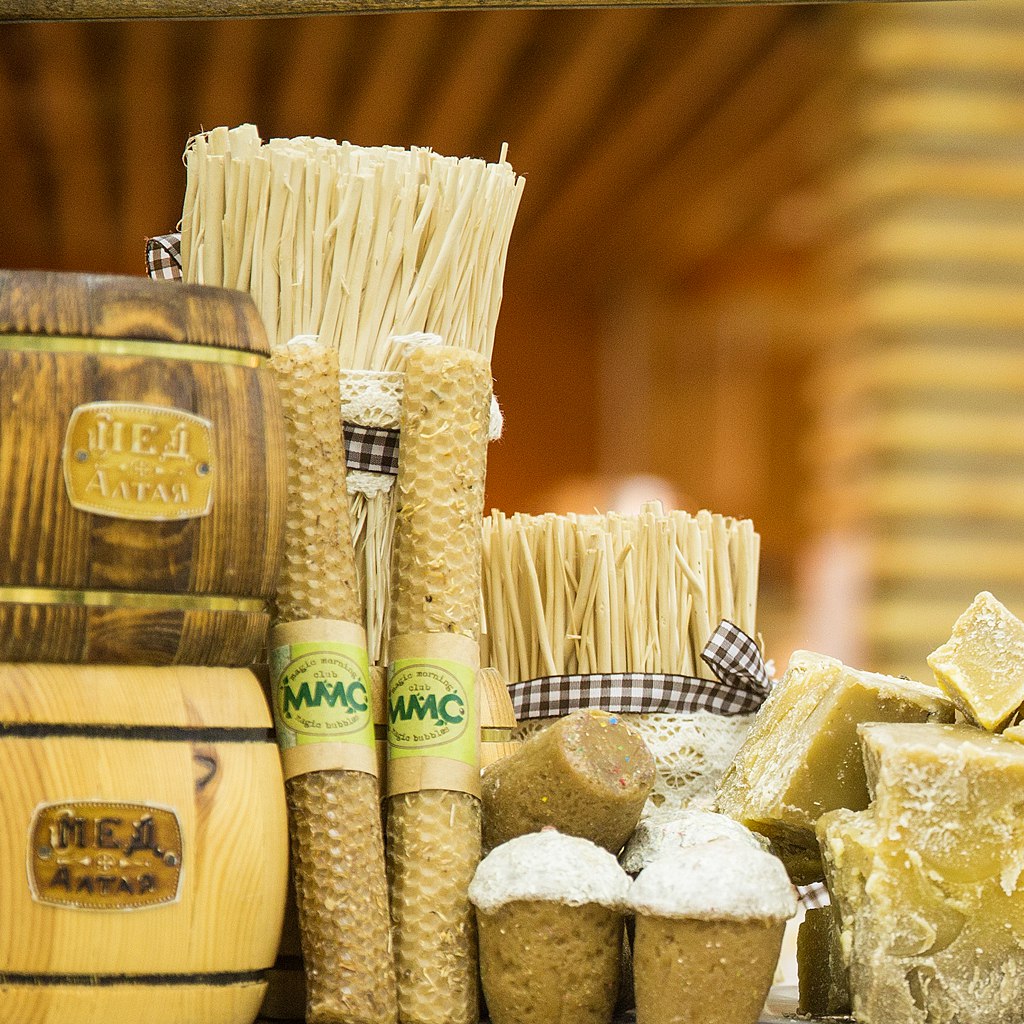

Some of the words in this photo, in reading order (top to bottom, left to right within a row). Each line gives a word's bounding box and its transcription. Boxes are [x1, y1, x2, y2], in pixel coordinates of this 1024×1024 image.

[313, 670, 338, 679] club
[415, 670, 455, 693] morning
[408, 684, 431, 692] club
[283, 680, 369, 713] MMC
